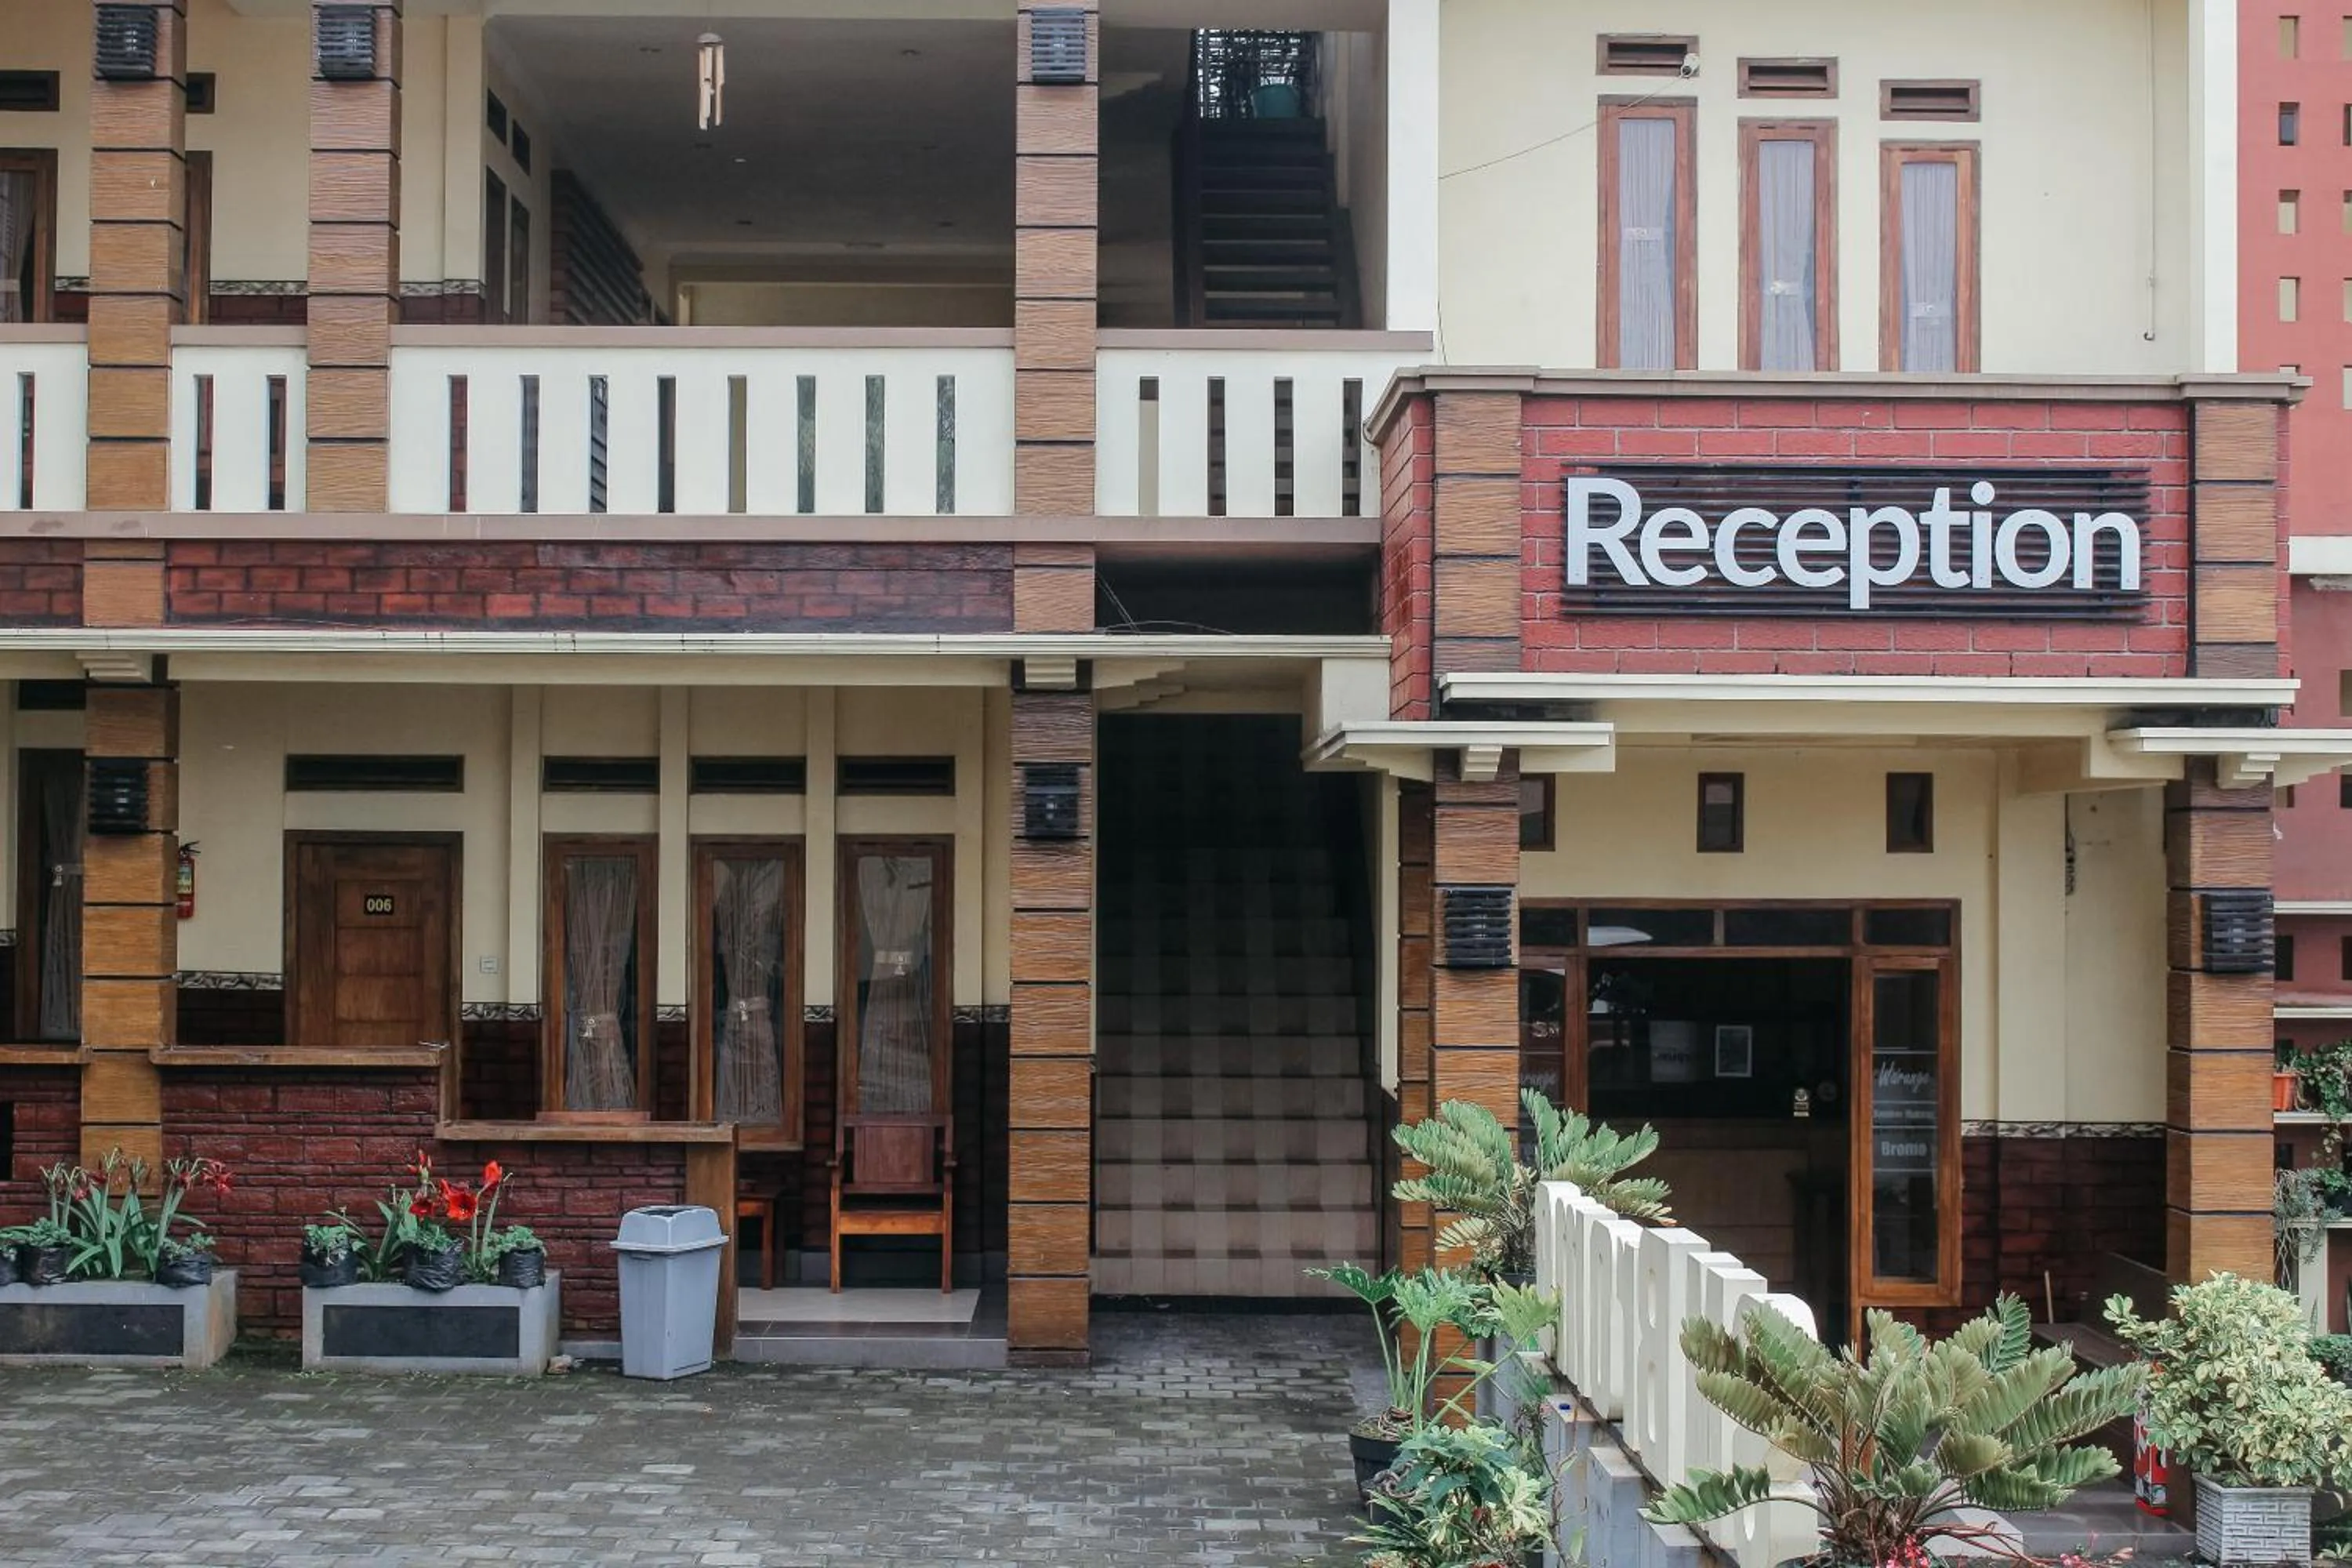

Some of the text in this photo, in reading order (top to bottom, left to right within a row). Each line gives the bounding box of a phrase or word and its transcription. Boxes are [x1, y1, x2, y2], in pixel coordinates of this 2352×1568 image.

[1566, 477, 2140, 609] Reception
[366, 897, 392, 913] 006
[1882, 1141, 1927, 1156] Bromo
